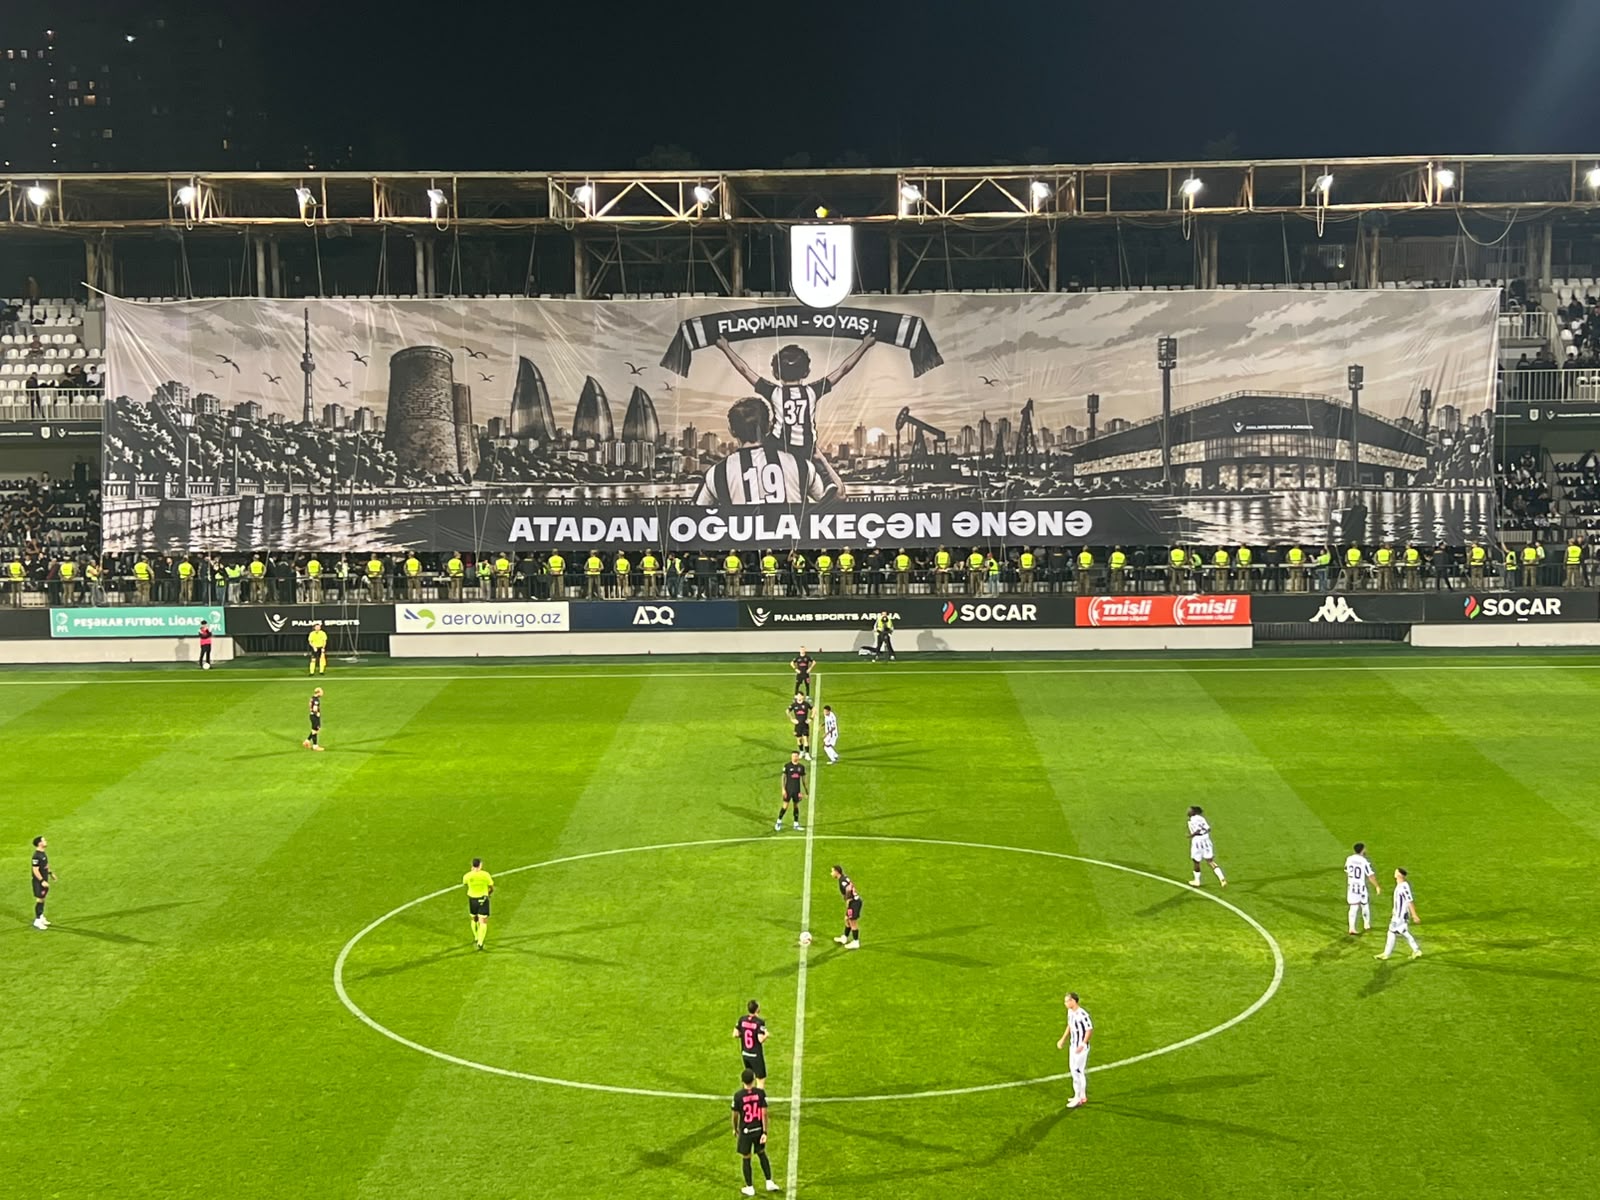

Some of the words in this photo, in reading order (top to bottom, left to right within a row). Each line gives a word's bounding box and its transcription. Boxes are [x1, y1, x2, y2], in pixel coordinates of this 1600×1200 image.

[812, 314, 836, 329] 90
[838, 315, 869, 335] YAŞ
[784, 400, 808, 426] 37
[743, 463, 786, 504] 19
[508, 516, 658, 542] ATADAN
[669, 508, 801, 541] OĞULA
[809, 512, 941, 547] KEÇƏN
[951, 510, 1093, 537] ƏNƏNƏ
[632, 606, 675, 626] ADQ
[960, 604, 1037, 622] SOCAR
[1102, 599, 1153, 616] misli
[1186, 598, 1238, 615] misli
[1482, 597, 1561, 616] SOCAR
[73, 617, 124, 630] PEŞƏKAR
[125, 616, 166, 627] FUTBOL
[441, 611, 561, 628] aerowingo.az
[773, 613, 813, 622] PALMS
[814, 612, 860, 621] SPORTS
[744, 1029, 754, 1049] 6
[743, 1103, 760, 1122] 34
